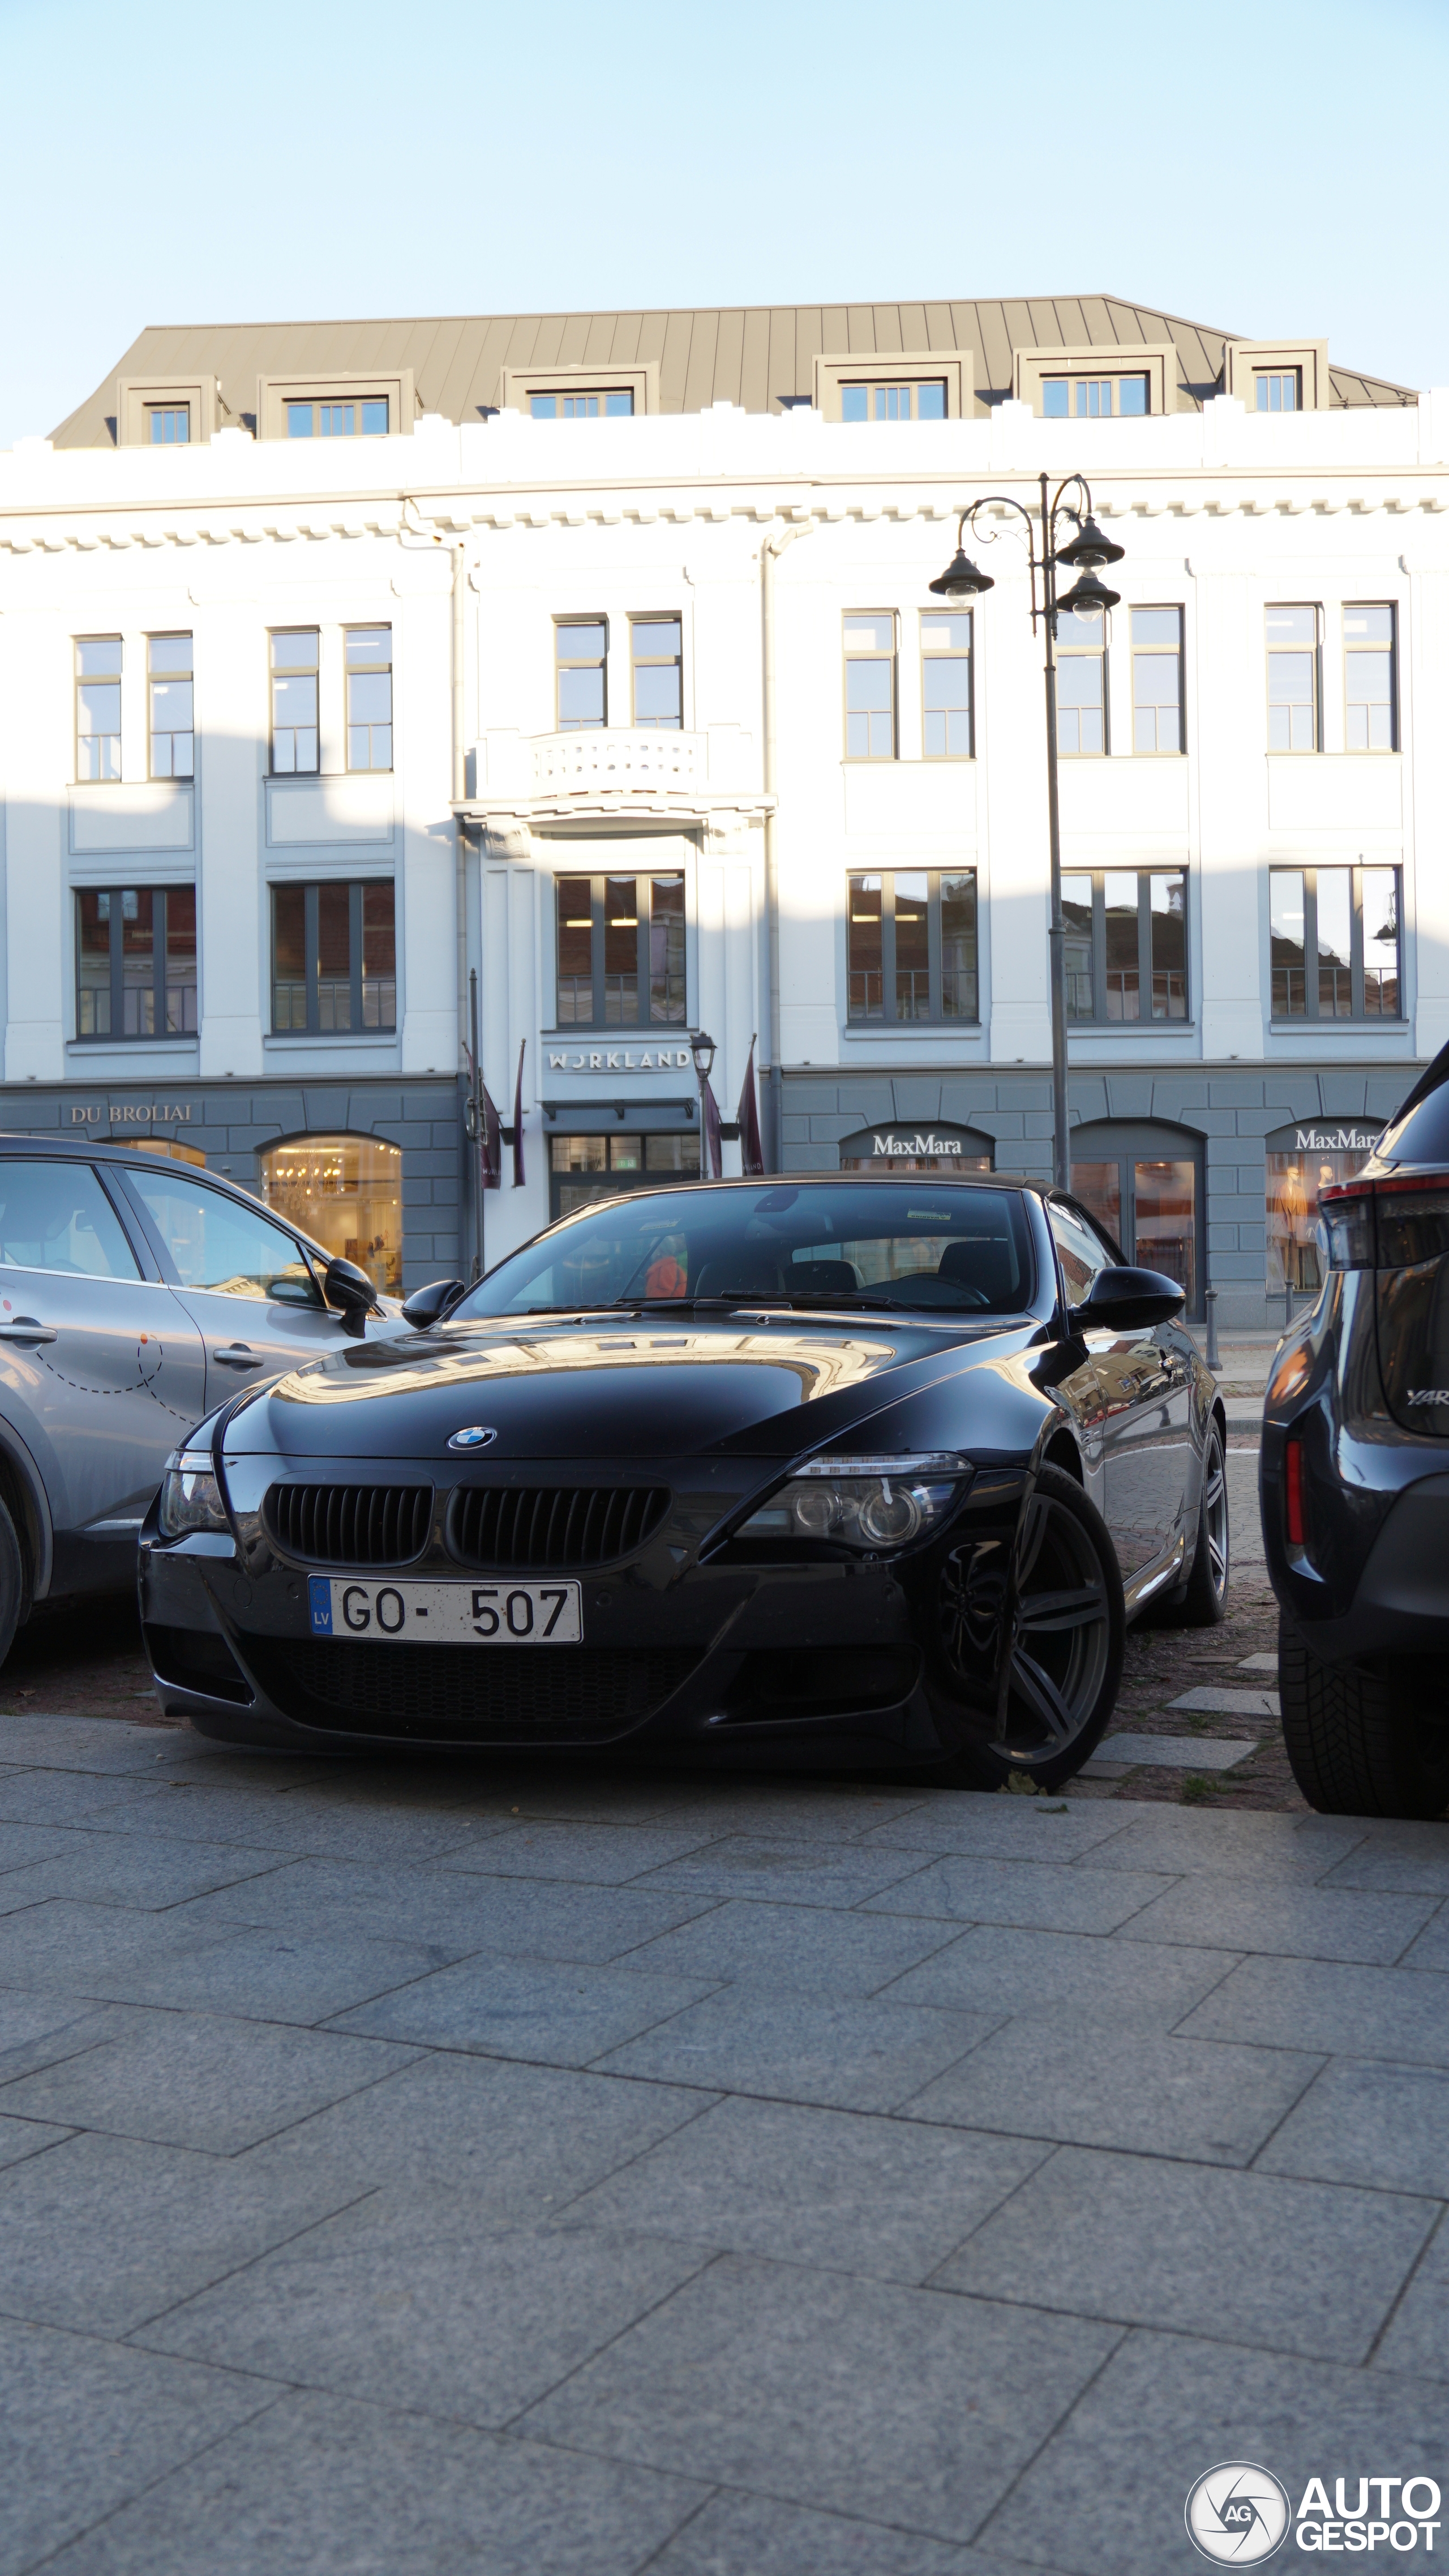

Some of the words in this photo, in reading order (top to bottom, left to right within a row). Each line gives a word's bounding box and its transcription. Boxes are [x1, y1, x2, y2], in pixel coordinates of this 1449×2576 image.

[549, 1051, 690, 1069] WORKLAND
[71, 1107, 101, 1123] DU
[109, 1105, 191, 1122] BROLIAI
[872, 1135, 961, 1154] MaxMara
[1295, 1129, 1381, 1149] MaxMar
[314, 1612, 329, 1625] LV
[471, 1589, 568, 1636] 507
